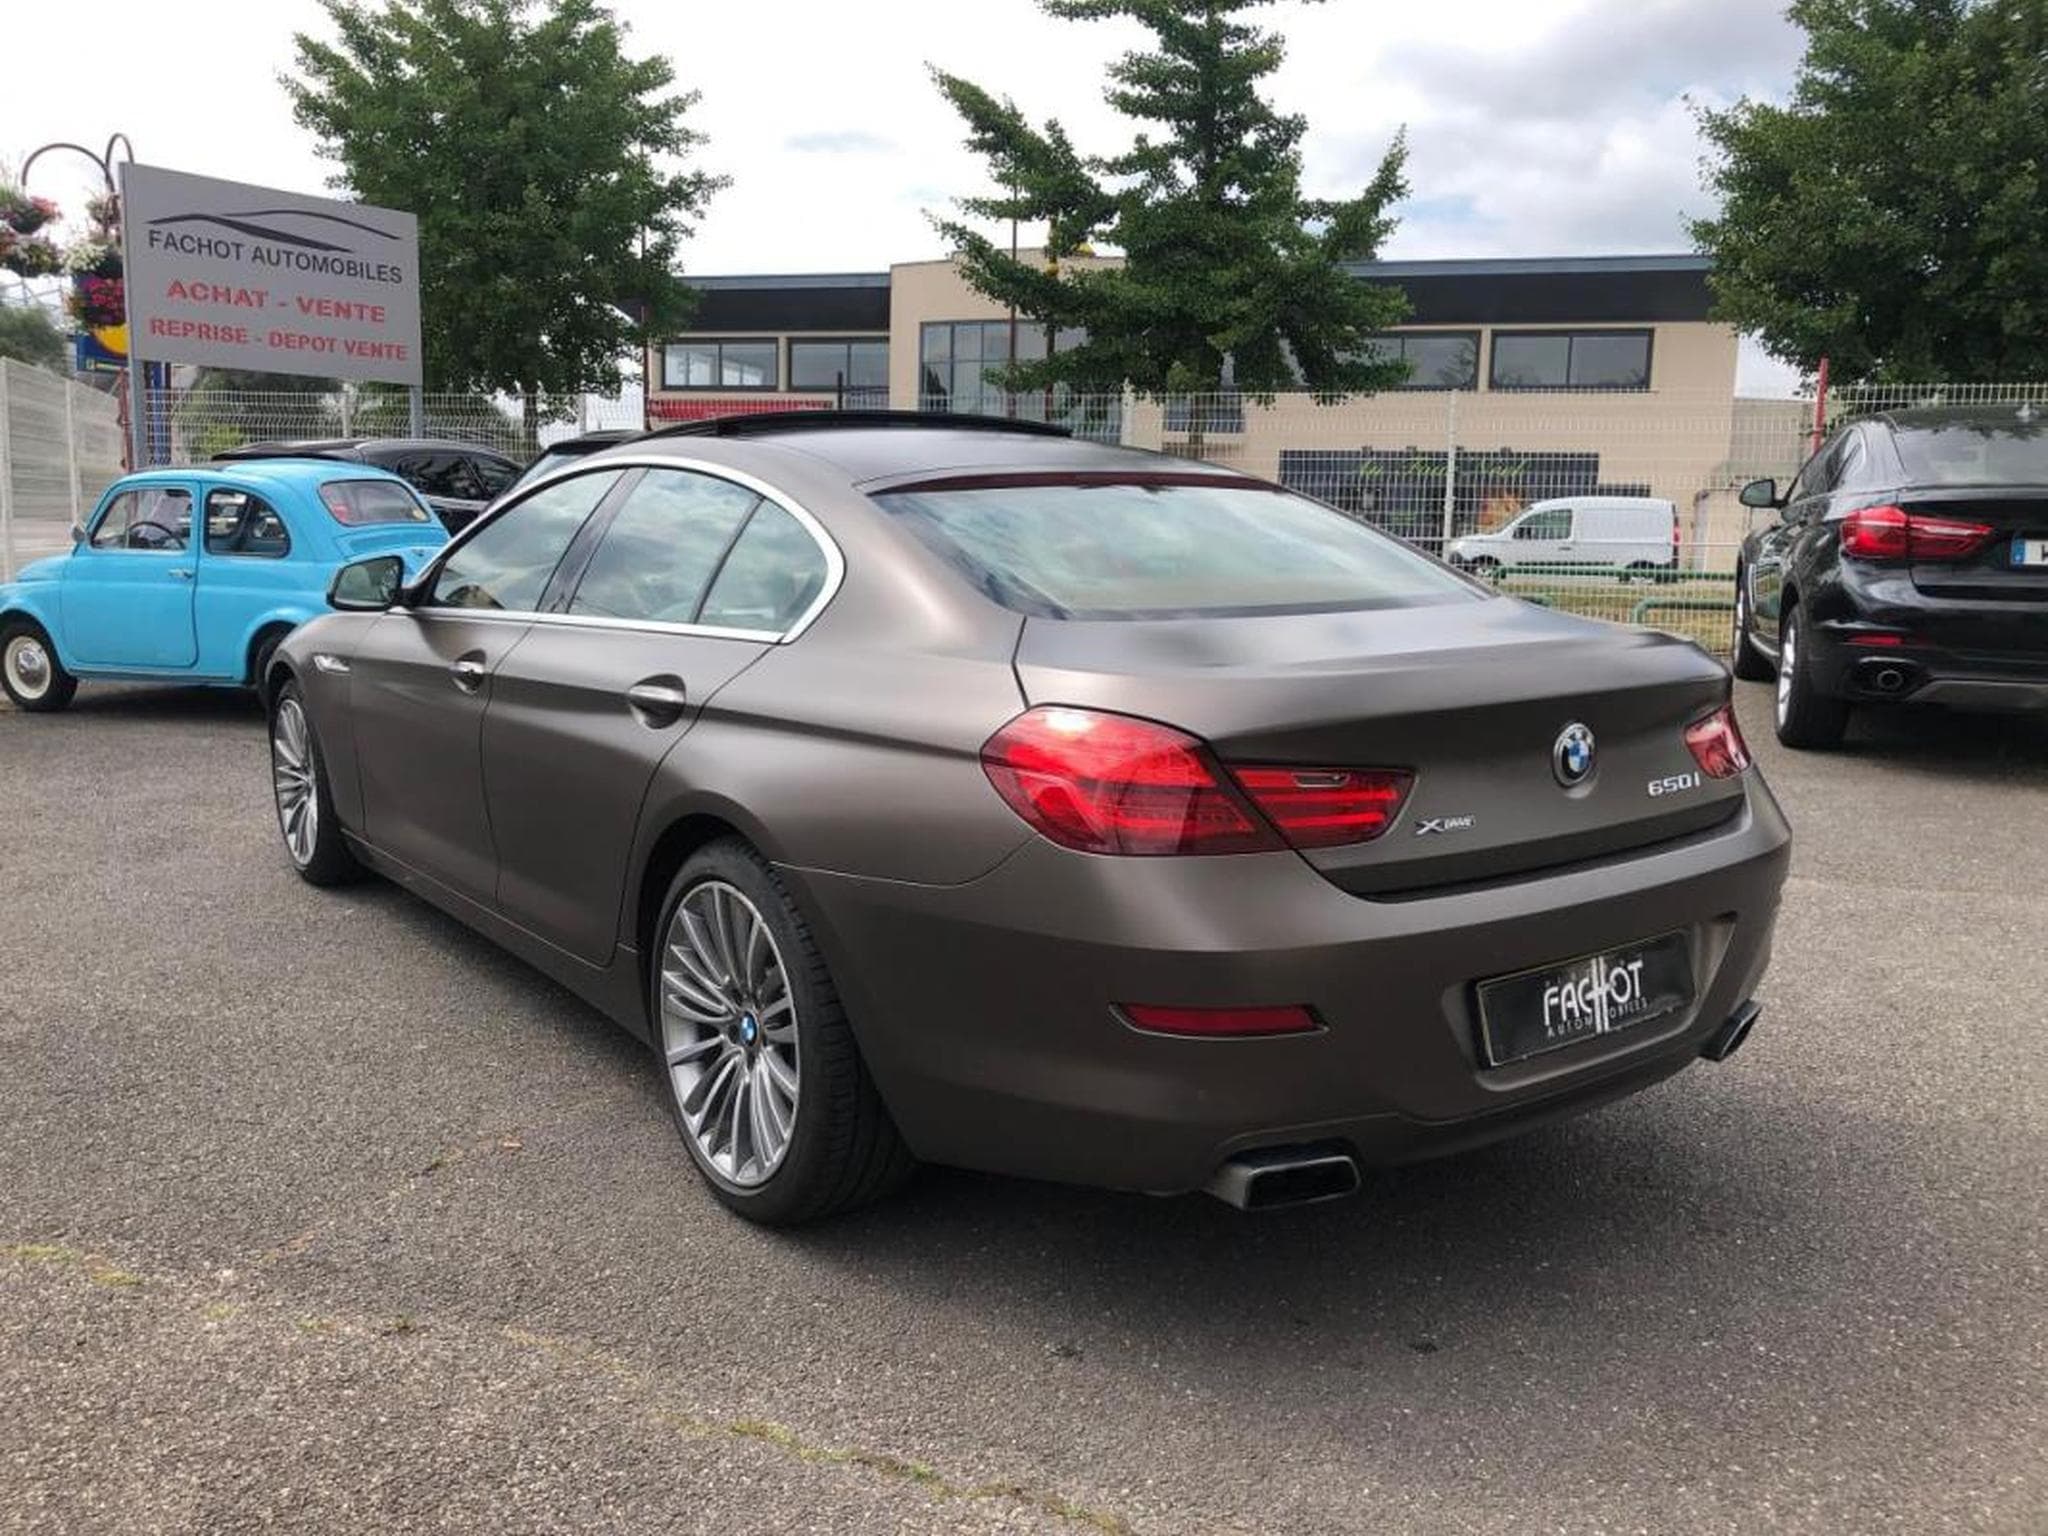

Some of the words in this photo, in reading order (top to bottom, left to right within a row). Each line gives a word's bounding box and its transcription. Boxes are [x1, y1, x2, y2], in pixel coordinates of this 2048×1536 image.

[149, 229, 245, 260] FACHOT
[251, 246, 402, 284] AUTOMOBILES
[166, 279, 269, 308] ACHAT
[296, 295, 385, 323] VENTE
[149, 318, 248, 344] REPRISE
[269, 331, 336, 354] DEPOT
[344, 339, 408, 361] VENTE
[1543, 956, 1644, 1034] FACHOT
